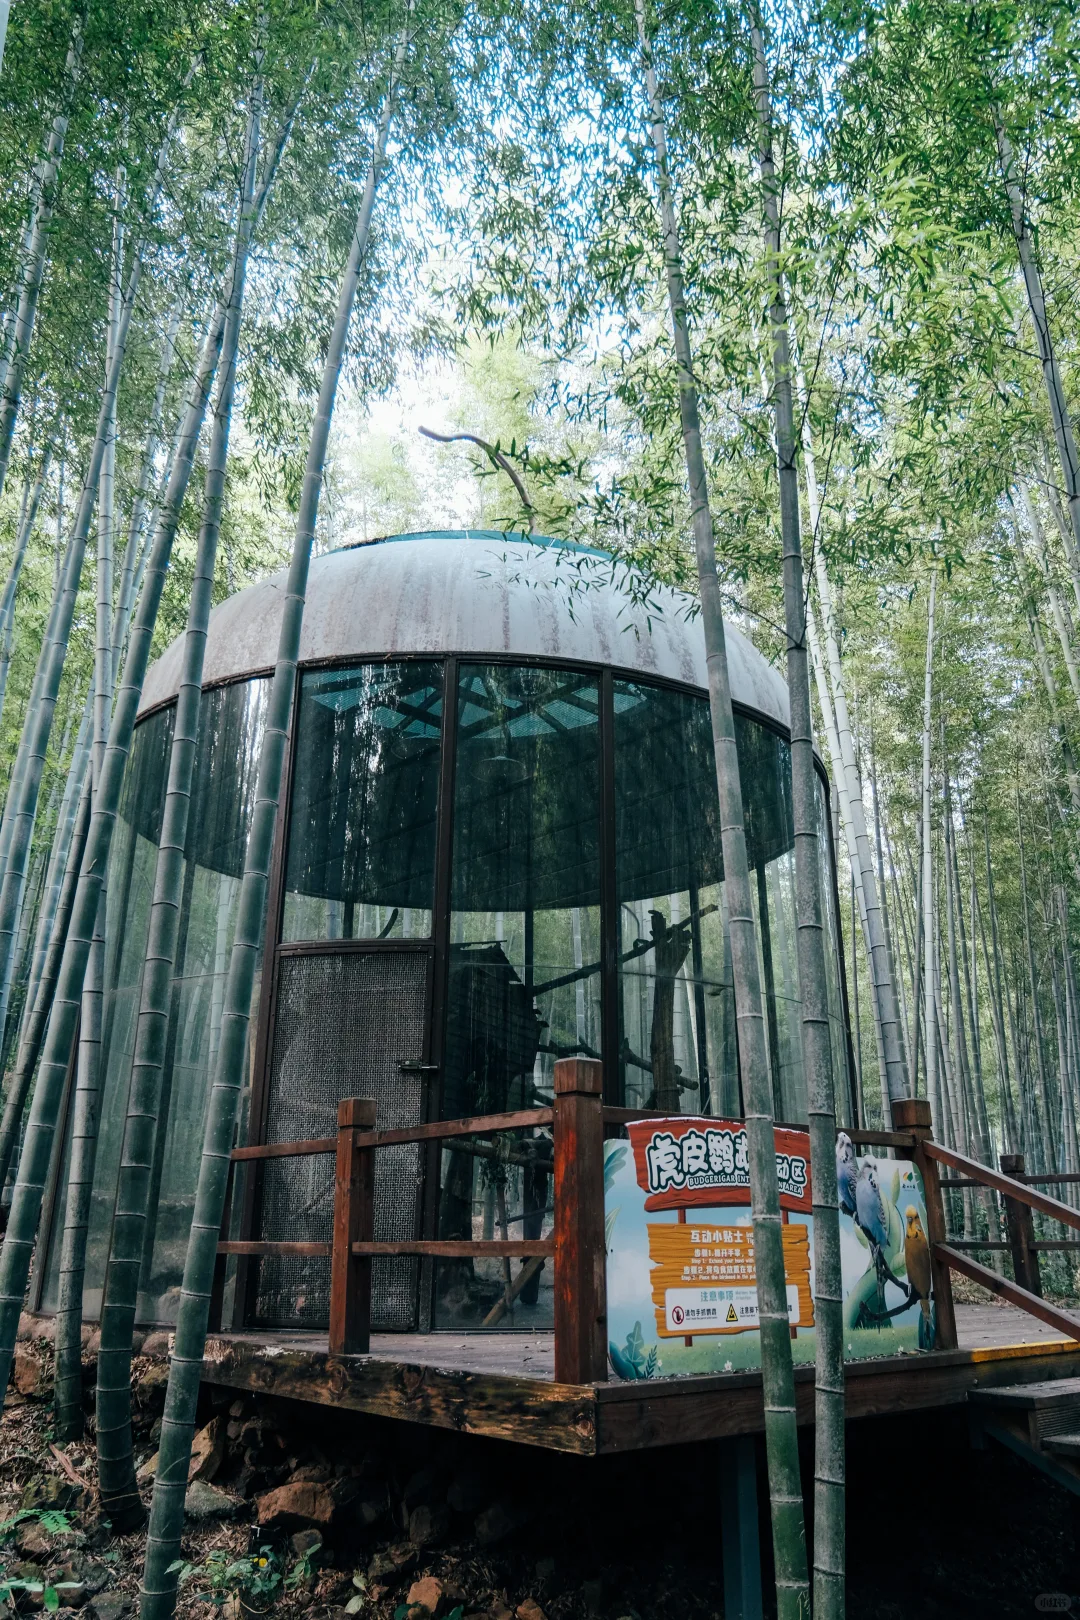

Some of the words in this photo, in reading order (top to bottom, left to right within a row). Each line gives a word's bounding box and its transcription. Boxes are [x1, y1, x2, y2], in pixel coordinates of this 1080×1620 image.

[688, 1174, 736, 1186] BUDGERIGAR
[785, 1184, 803, 1195] AREA
[690, 1230, 743, 1243] 互动小贴士
[701, 1290, 734, 1302] 注意事项
